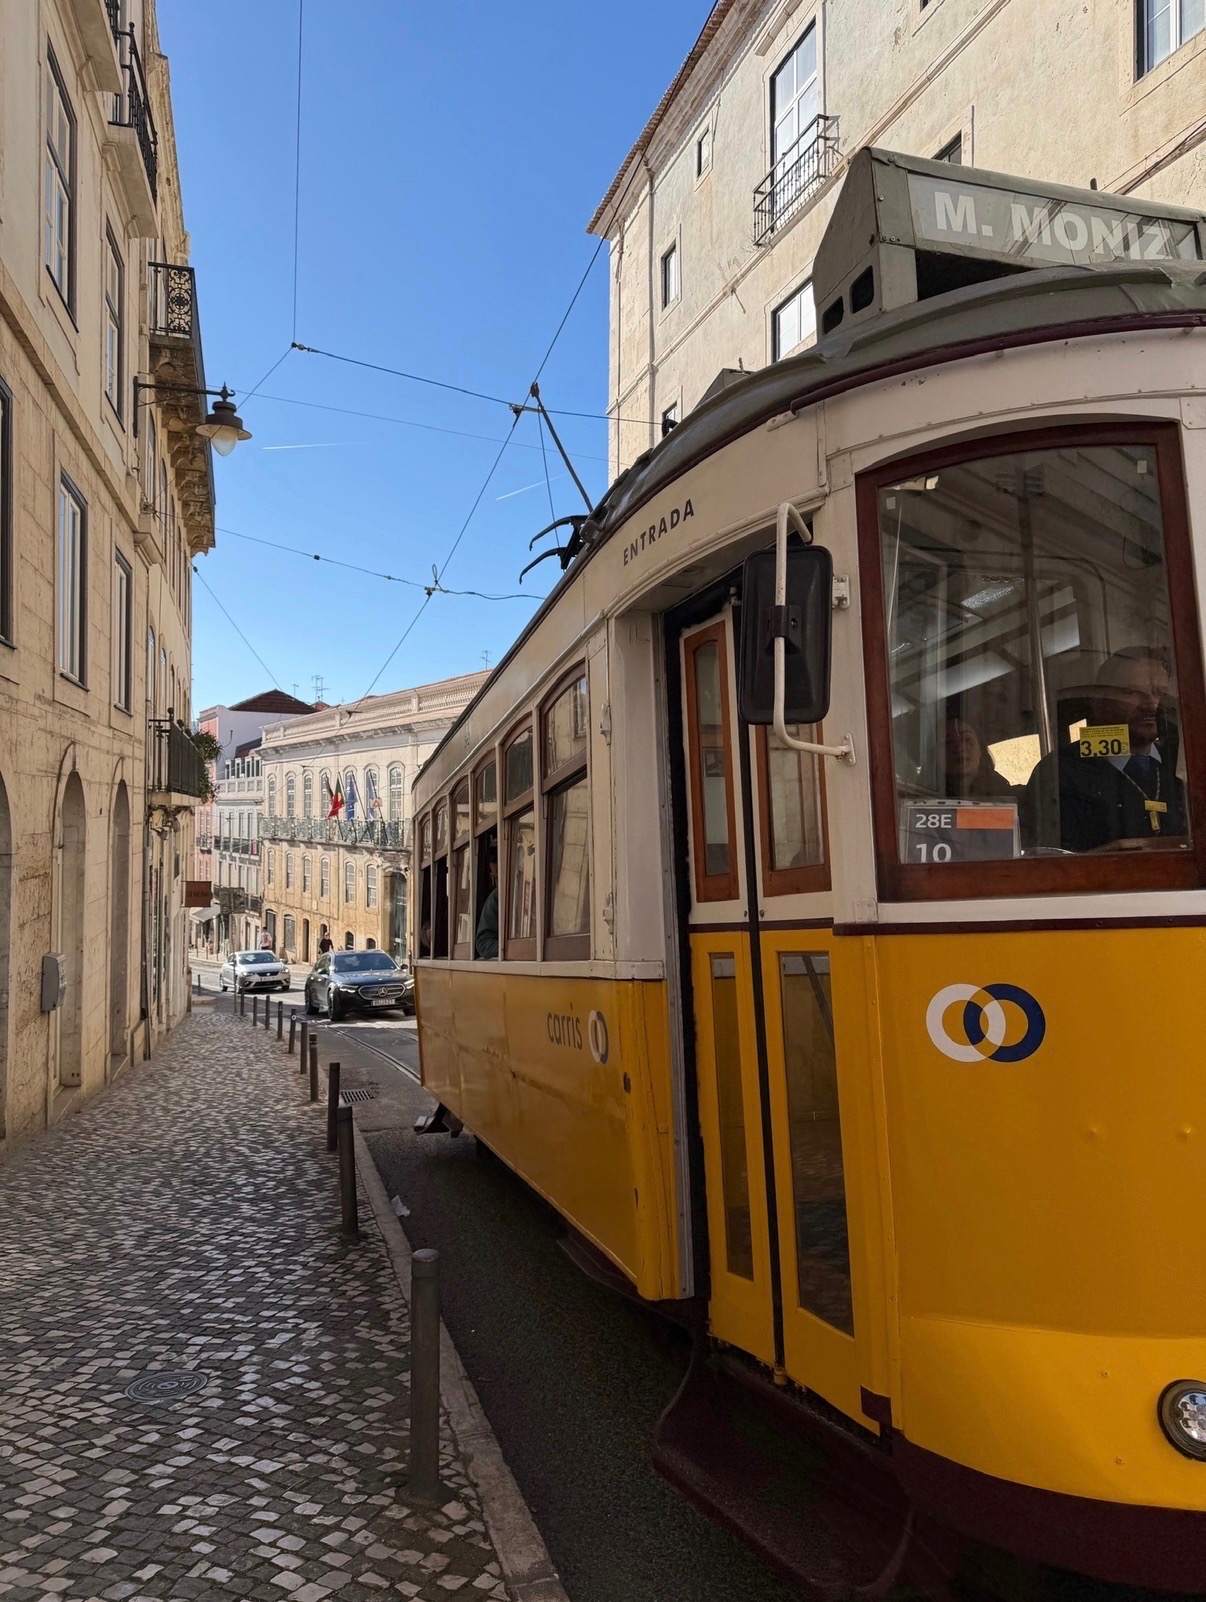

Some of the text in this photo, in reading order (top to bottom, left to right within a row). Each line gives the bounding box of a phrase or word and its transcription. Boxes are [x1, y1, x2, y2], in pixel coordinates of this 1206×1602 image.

[934, 191, 1173, 260] M. MONIZ
[623, 498, 695, 567] ENTRADA
[1080, 739, 1122, 757] 3.30
[915, 814, 952, 828] 28E
[915, 843, 952, 863] 10
[547, 1002, 583, 1050] carris
